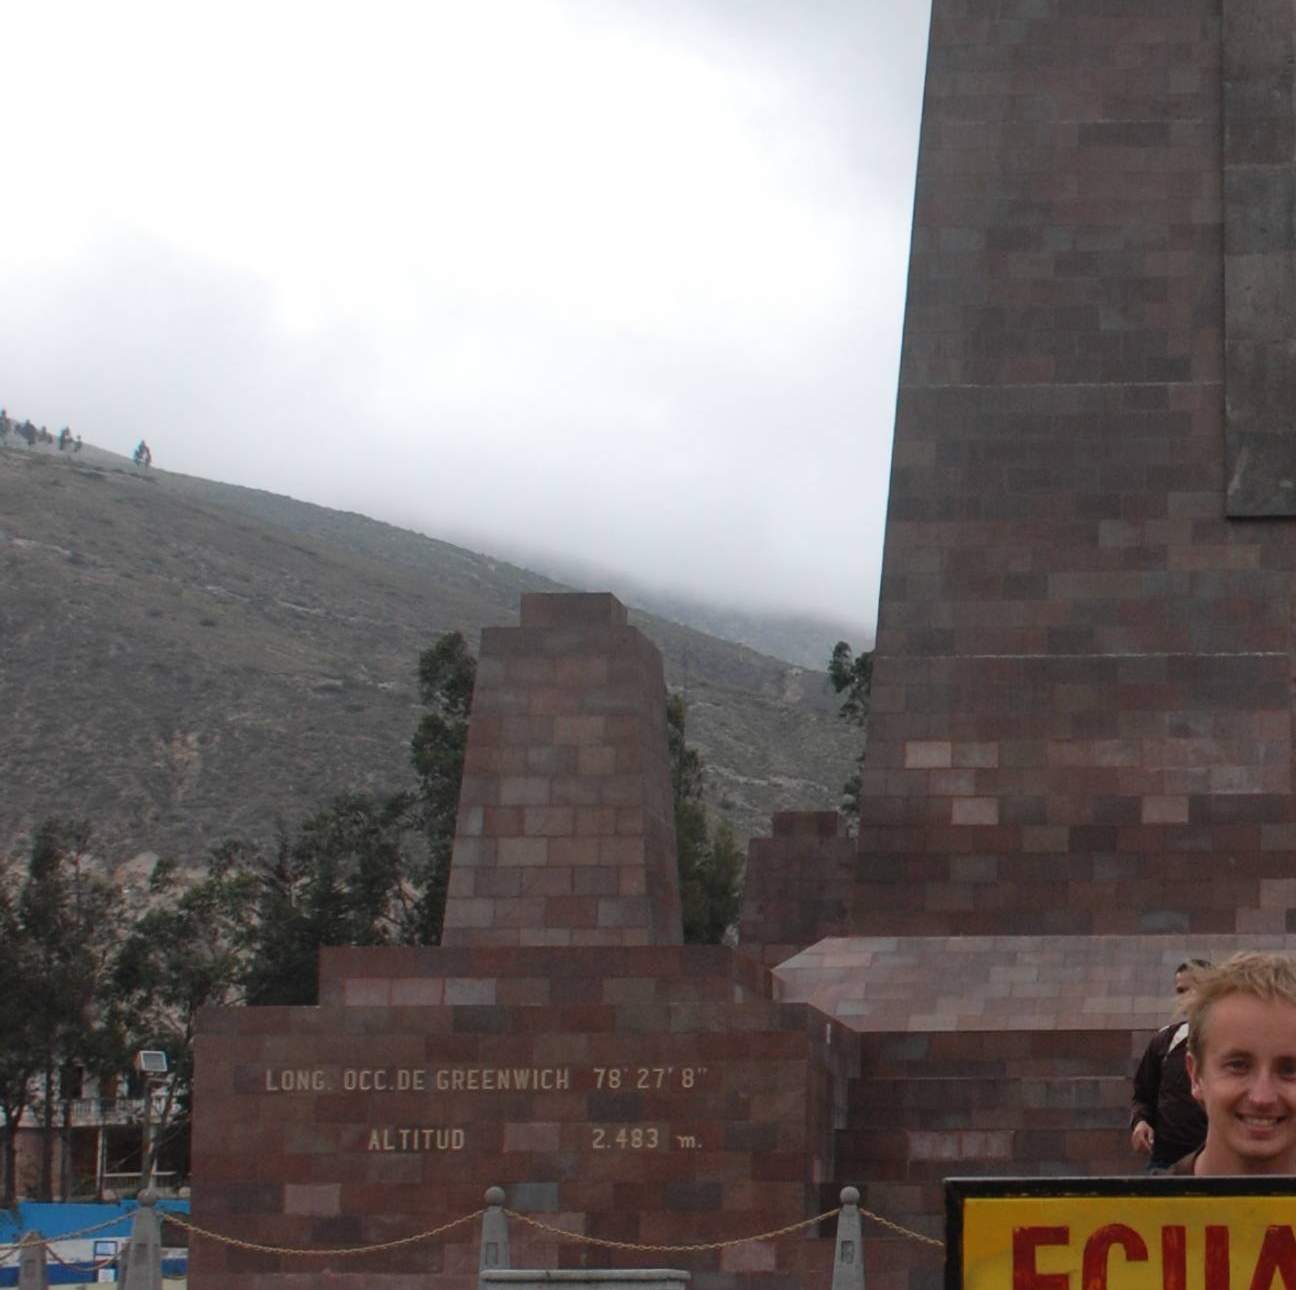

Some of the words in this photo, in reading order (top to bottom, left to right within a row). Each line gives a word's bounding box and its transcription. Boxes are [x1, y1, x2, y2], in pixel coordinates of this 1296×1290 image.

[264, 1068, 333, 1091] LONG.
[436, 1068, 570, 1091] GREENWICH
[367, 1128, 465, 1151] ALTITUD
[592, 1127, 659, 1149] 2.483
[676, 1135, 703, 1149] m.
